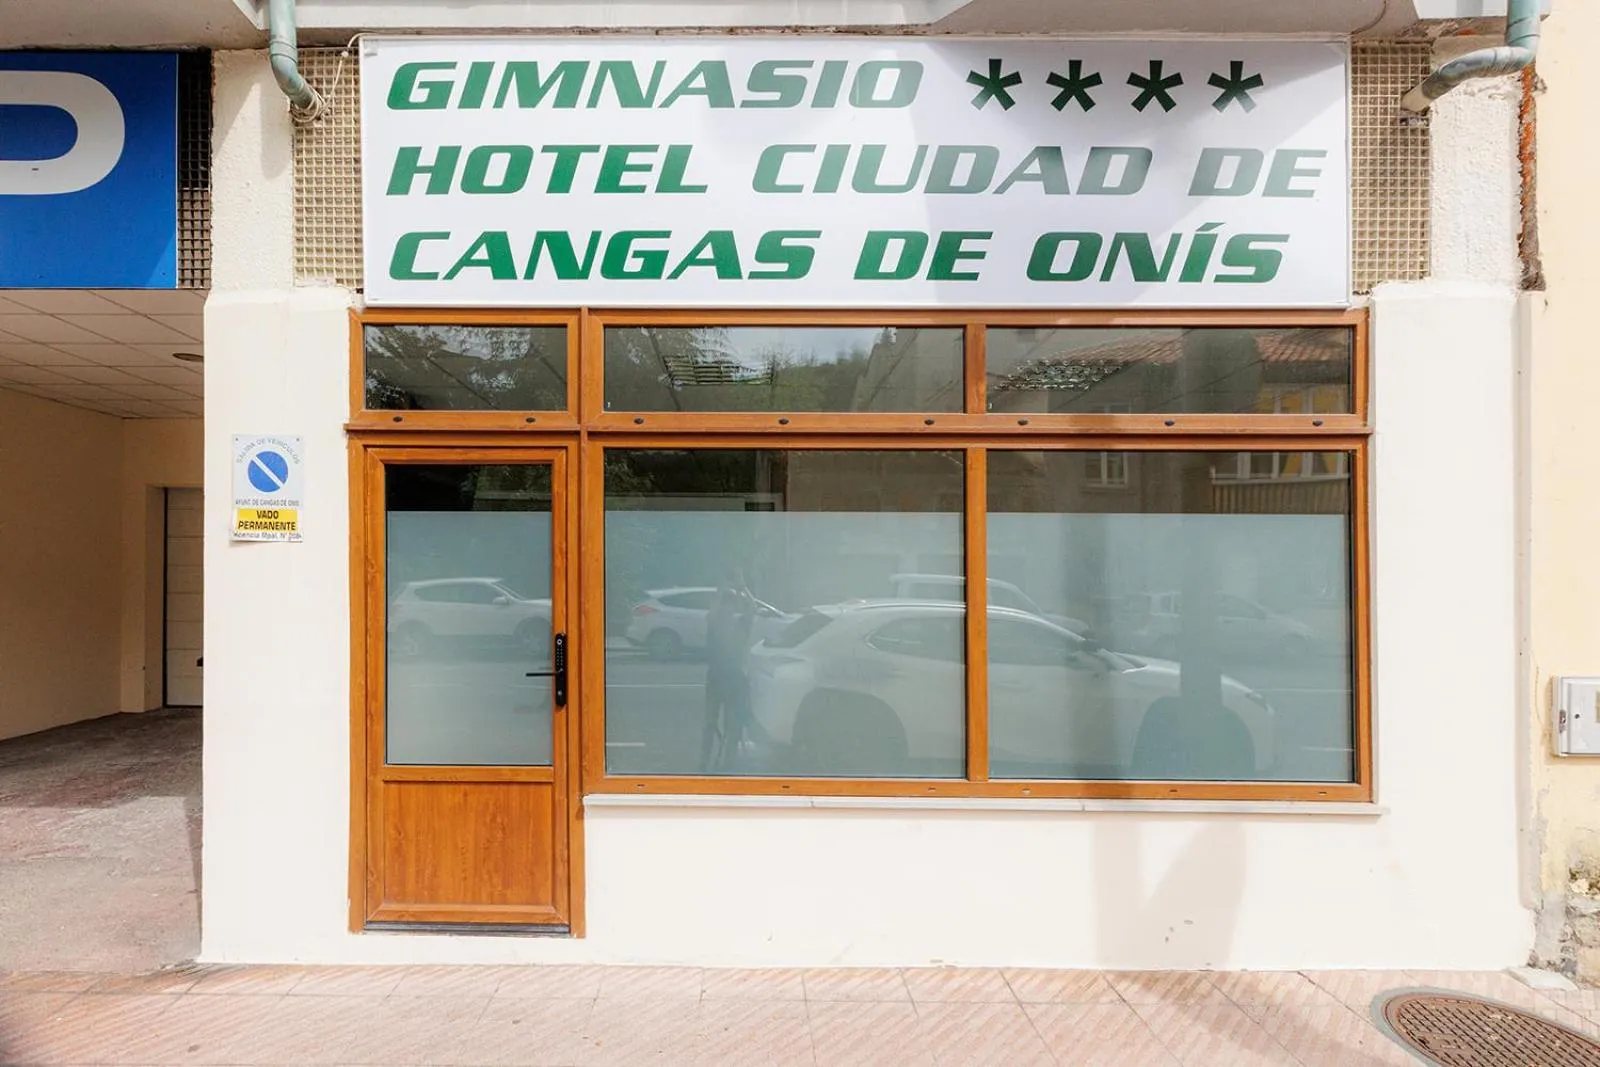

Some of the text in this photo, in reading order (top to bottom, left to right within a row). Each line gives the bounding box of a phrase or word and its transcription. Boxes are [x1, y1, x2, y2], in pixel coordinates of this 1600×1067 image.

[387, 60, 924, 111] GIMNASIO
[386, 144, 1328, 198] HOTEL CIUDAD DE
[388, 221, 1291, 283] CANGAS DE ONÍS
[238, 520, 296, 531] PERMANENTE
[256, 510, 279, 519] VADO
